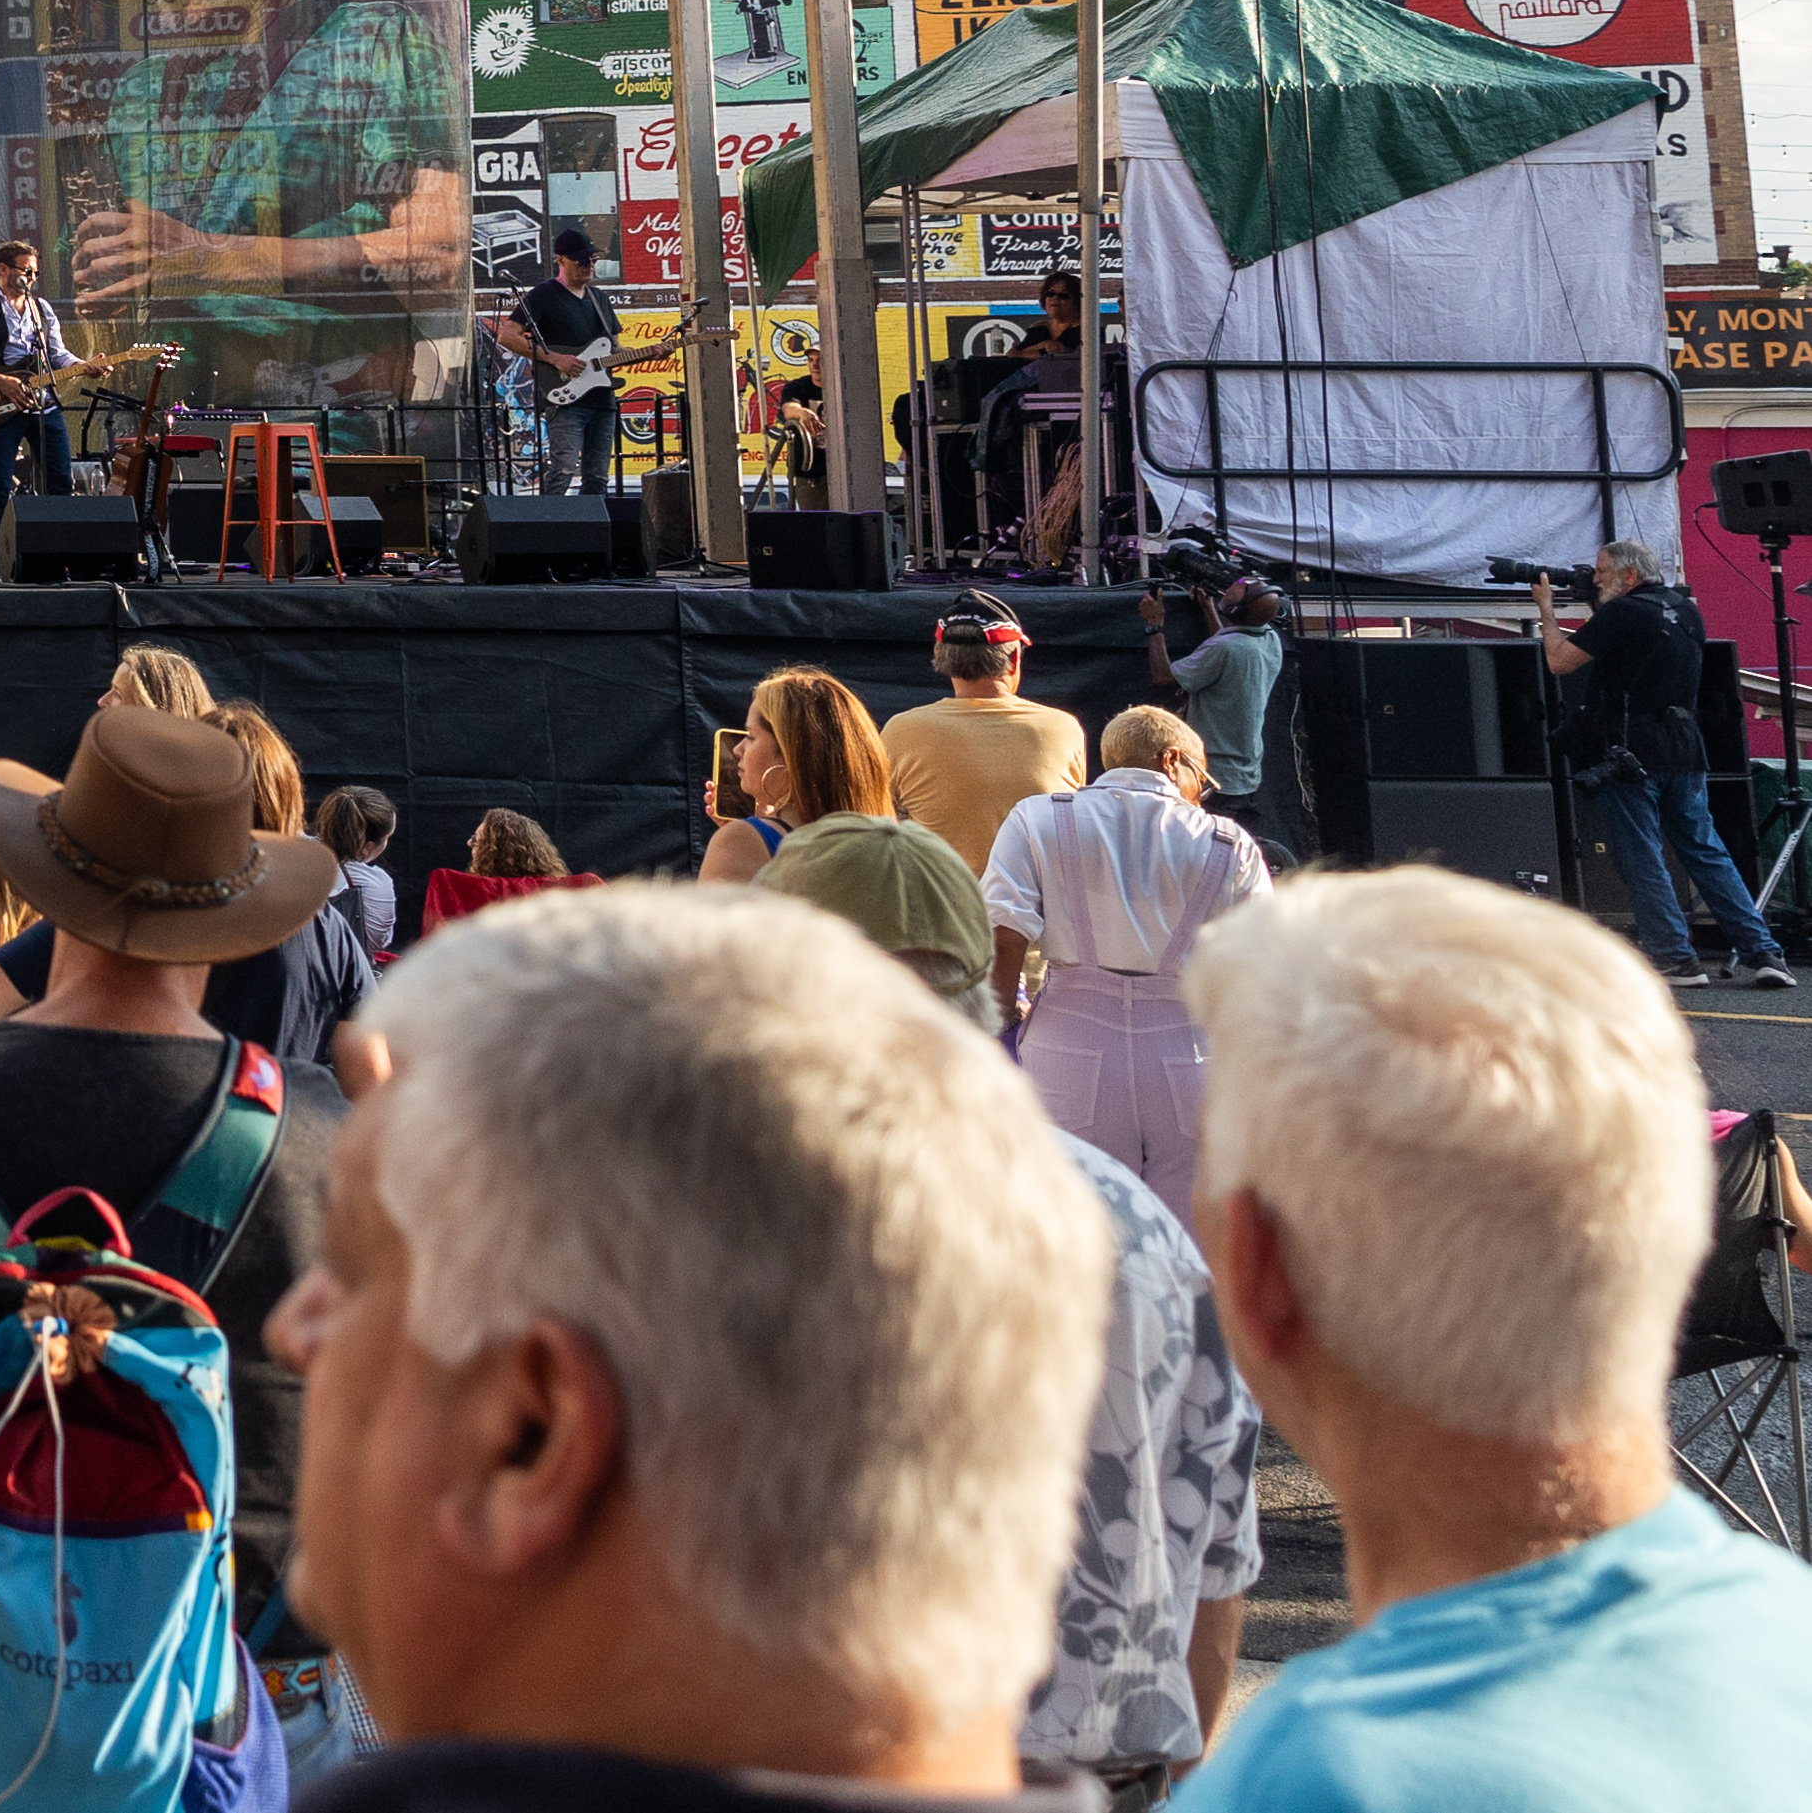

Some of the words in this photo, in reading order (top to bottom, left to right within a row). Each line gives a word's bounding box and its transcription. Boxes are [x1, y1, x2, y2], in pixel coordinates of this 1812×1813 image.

[477, 150, 542, 183] GRA
[989, 235, 1059, 253] Finer
[986, 256, 1054, 273] through
[1673, 342, 1751, 370] ASE
